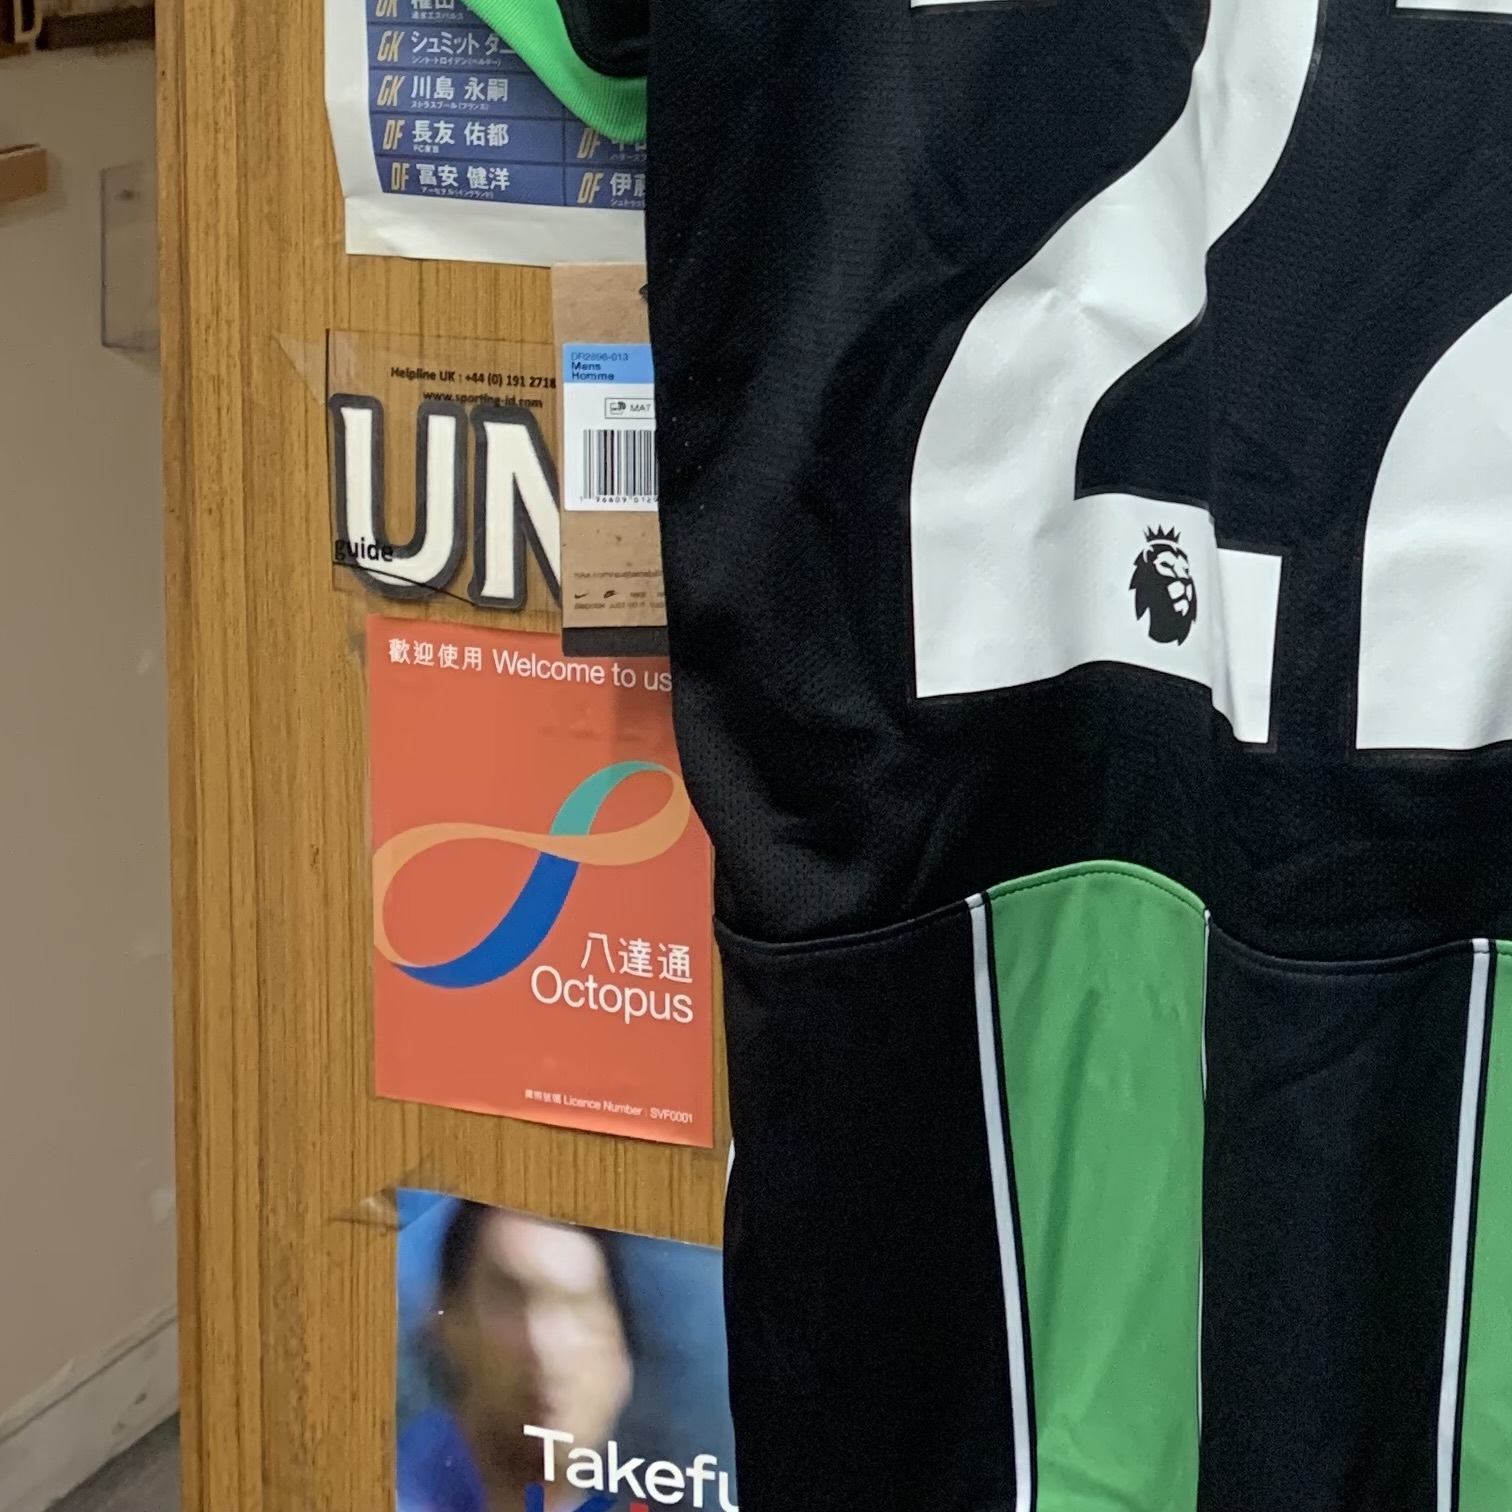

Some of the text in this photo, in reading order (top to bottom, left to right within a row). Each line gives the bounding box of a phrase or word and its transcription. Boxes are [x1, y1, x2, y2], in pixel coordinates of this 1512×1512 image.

[377, 30, 405, 62] GK
[411, 31, 480, 55] シュミット
[377, 75, 405, 107] GK
[411, 76, 454, 100] 川島
[412, 120, 509, 147] 長友 佑都
[467, 165, 511, 191] 健洋
[576, 171, 605, 204] DF
[390, 366, 437, 381] Helpline
[439, 370, 456, 383] UK
[464, 373, 485, 384] +44
[487, 373, 503, 387] (0)
[506, 375, 526, 387] 191
[571, 361, 601, 371] Mens
[571, 371, 615, 381] Homme
[335, 537, 394, 562] guide
[492, 648, 605, 685] Welcome
[611, 662, 636, 689] to
[643, 670, 672, 692] us
[580, 932, 693, 984] 八達通
[531, 965, 694, 1025] Octopus
[563, 1095, 601, 1110] Licence
[603, 1100, 643, 1116] Number
